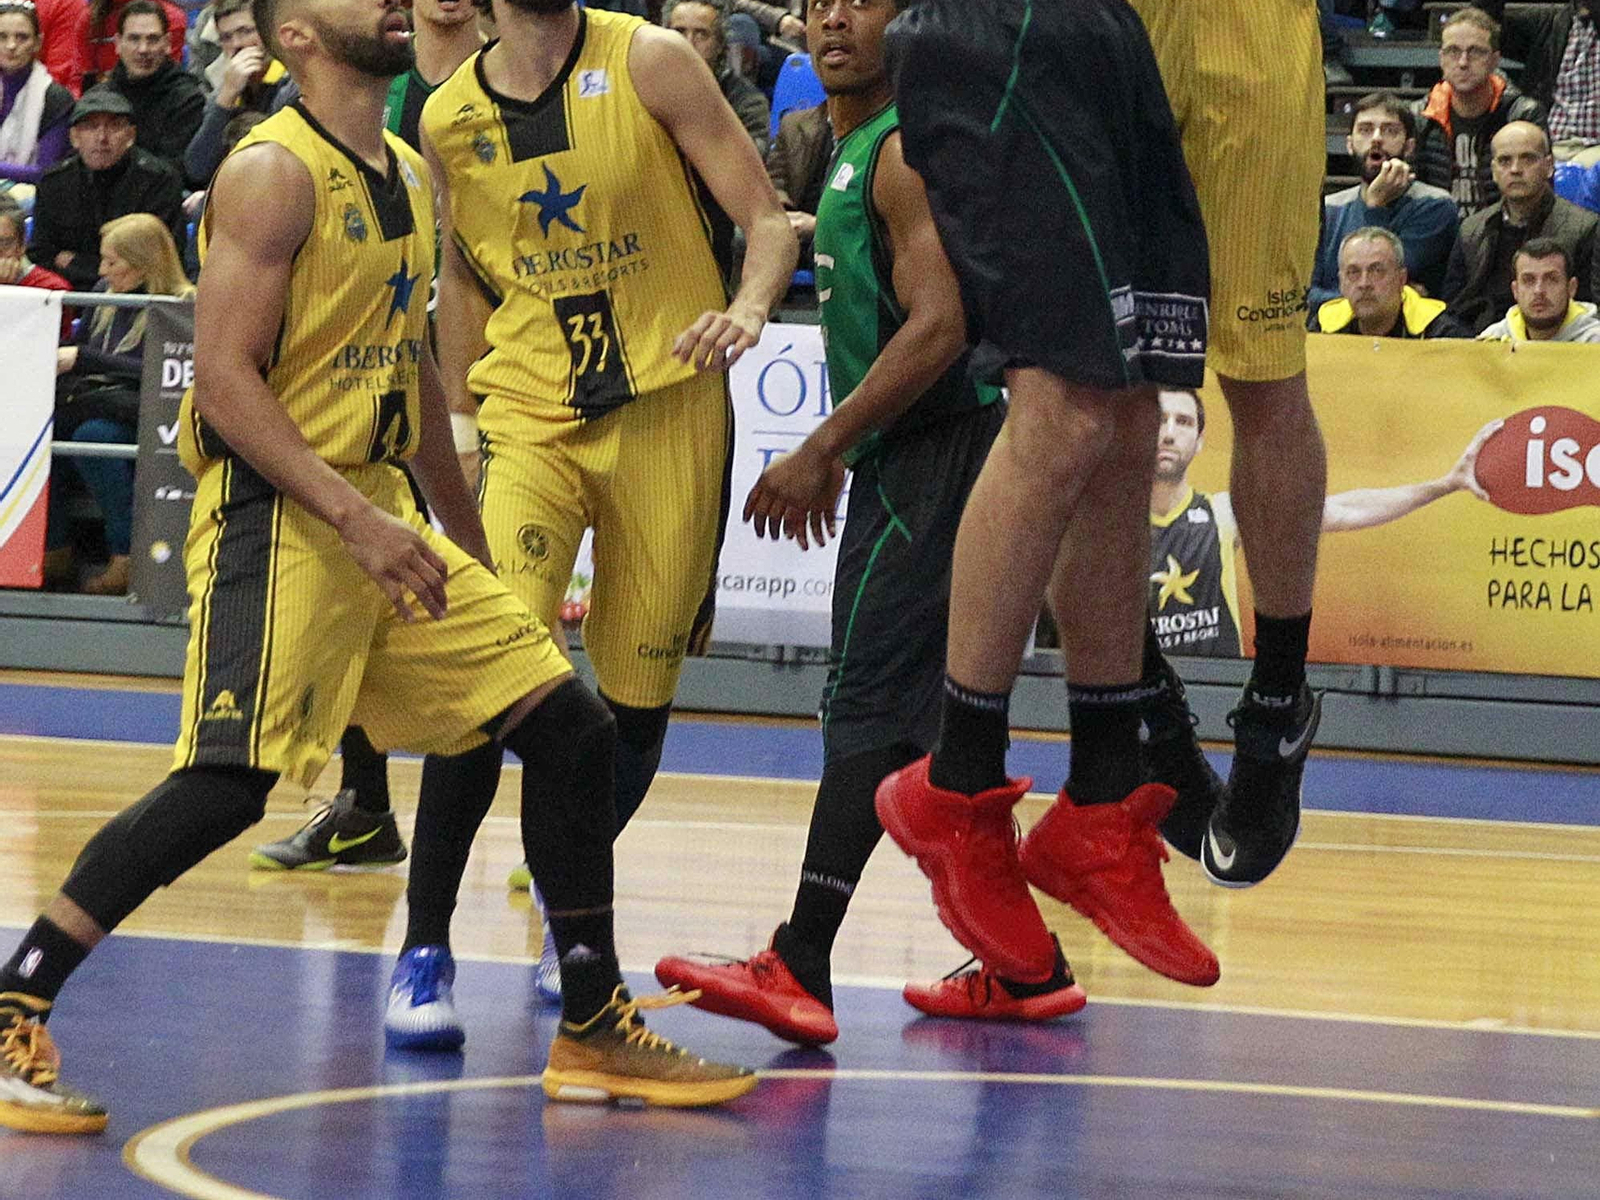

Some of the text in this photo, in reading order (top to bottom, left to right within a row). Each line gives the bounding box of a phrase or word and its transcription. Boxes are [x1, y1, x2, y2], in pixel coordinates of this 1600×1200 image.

[567, 311, 610, 377] 33
[1489, 537, 1600, 569] HECHOS
[1487, 579, 1593, 613] PARA LA
